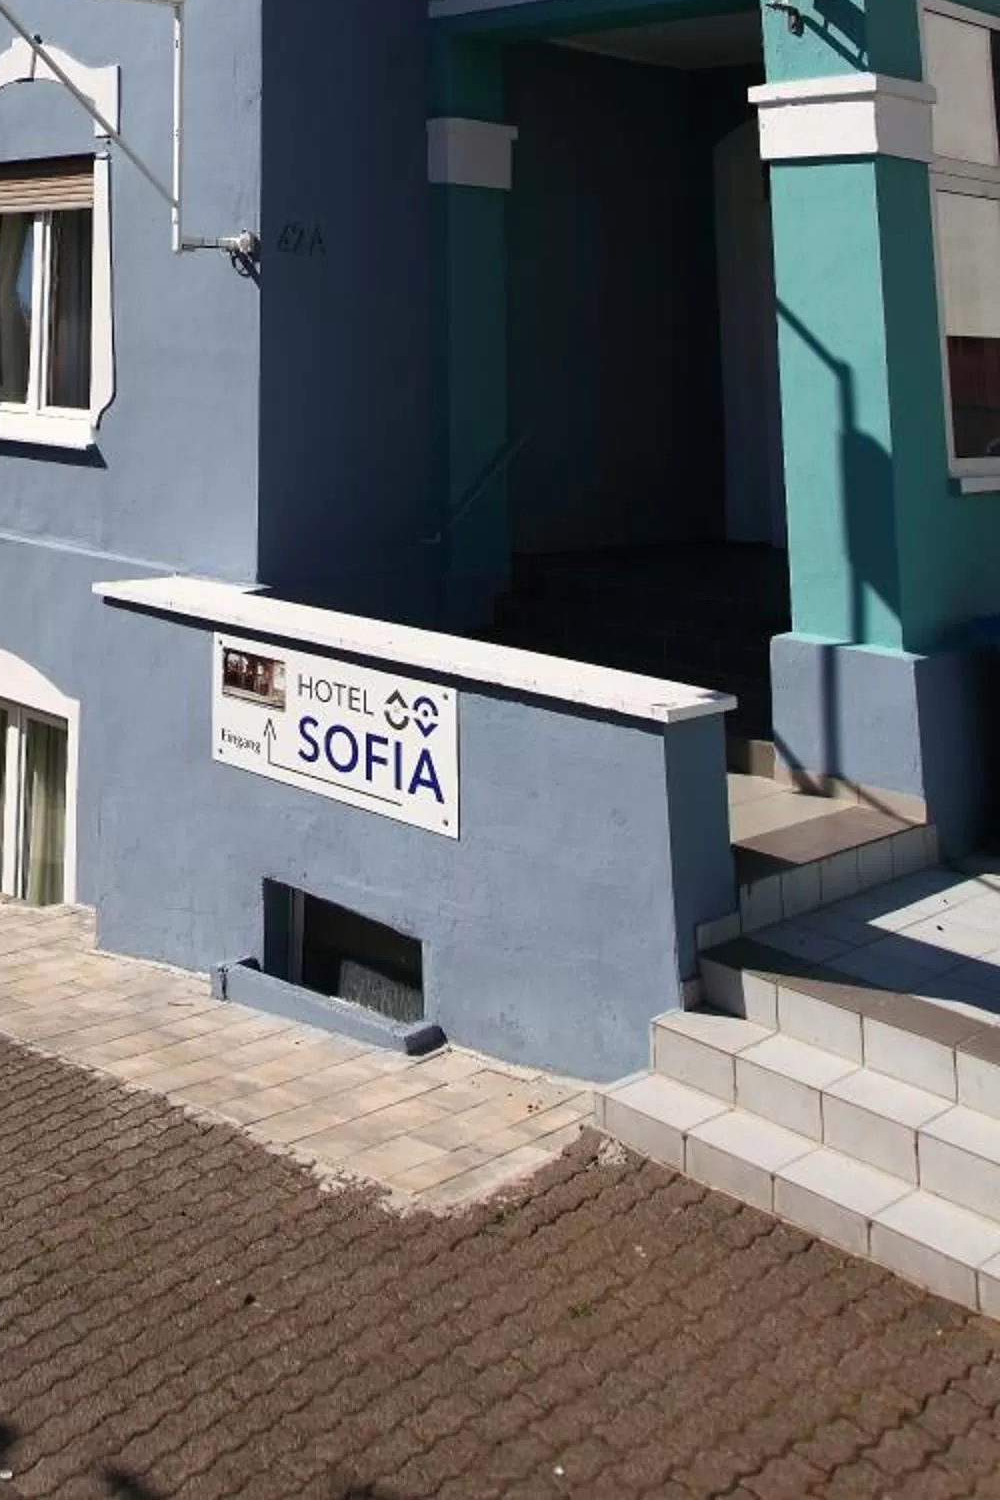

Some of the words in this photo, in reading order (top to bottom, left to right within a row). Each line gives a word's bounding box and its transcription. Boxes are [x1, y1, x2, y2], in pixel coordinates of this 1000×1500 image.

[298, 673, 375, 717] HOTEL
[221, 727, 261, 755] Eingang
[297, 715, 445, 805] SOFIA
